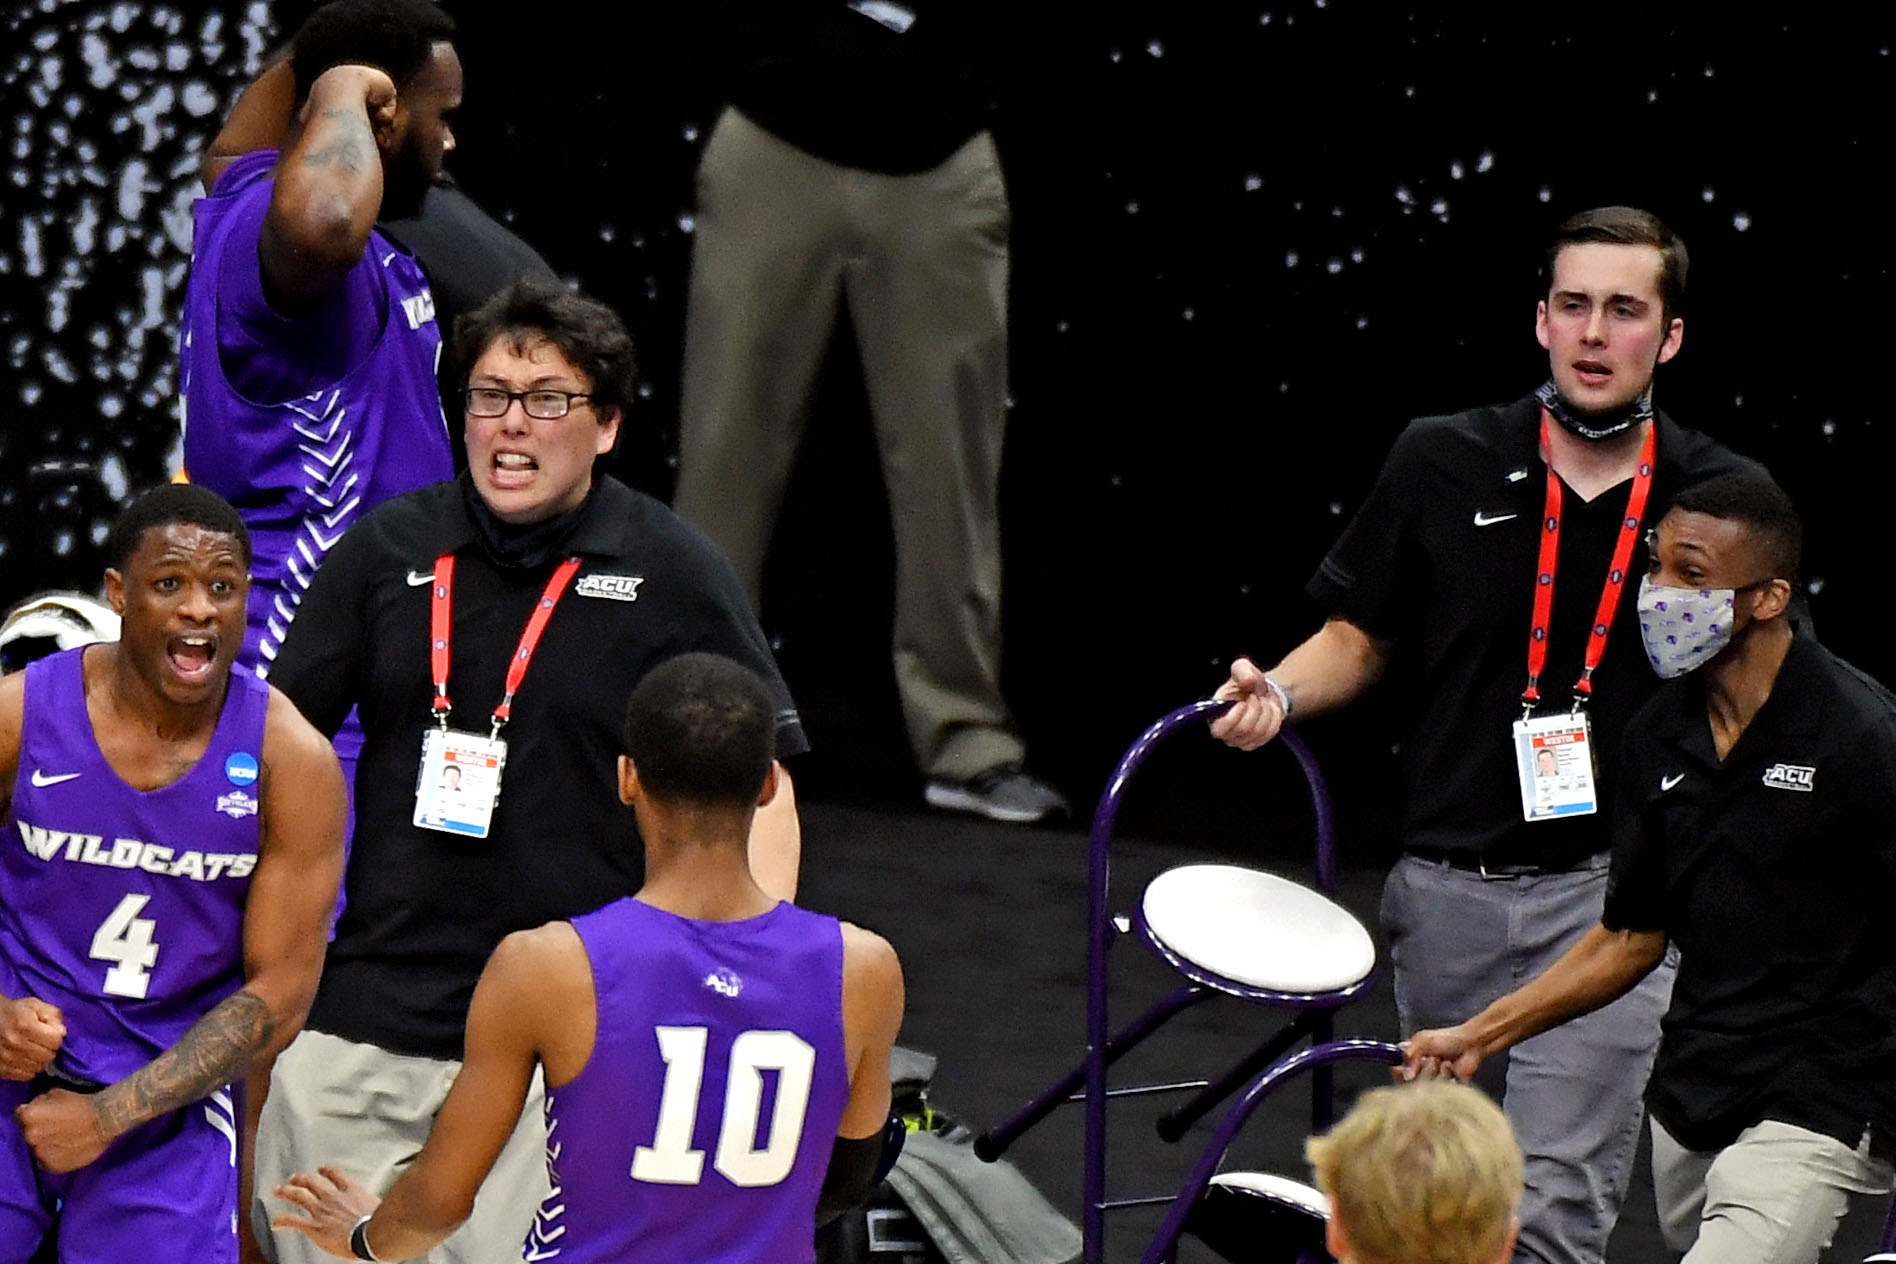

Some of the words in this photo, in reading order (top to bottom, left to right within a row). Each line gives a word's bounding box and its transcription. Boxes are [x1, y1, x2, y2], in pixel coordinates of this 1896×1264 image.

[583, 578, 633, 593] ACU
[1768, 766, 1812, 785] ACU
[17, 820, 258, 882] WILDCATS
[89, 893, 160, 1000] 4
[630, 1025, 816, 1188] 10
